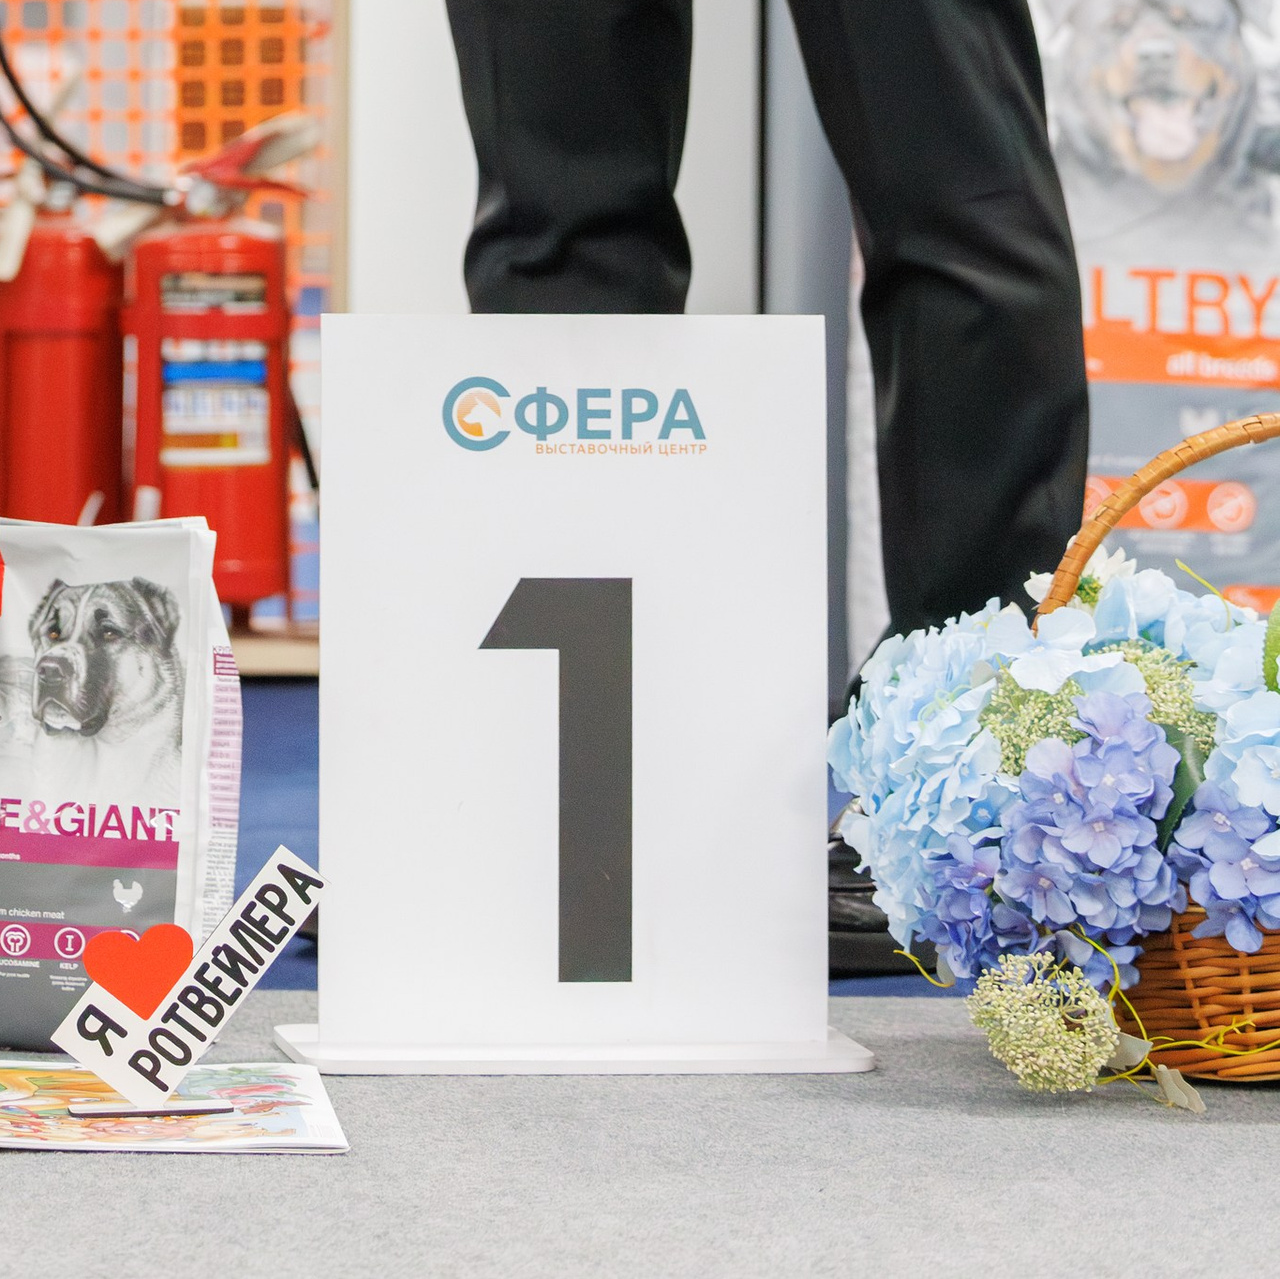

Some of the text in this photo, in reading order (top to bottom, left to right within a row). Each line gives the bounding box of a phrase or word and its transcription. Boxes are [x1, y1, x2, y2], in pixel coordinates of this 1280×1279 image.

[1091, 266, 1280, 336] LTRY
[442, 376, 707, 451] СФЕРА
[536, 441, 707, 456] ВЫСТАВОЧНЫЙ ЦЕНТР
[478, 578, 633, 982] 1
[8, 908, 41, 919] chicken
[42, 910, 65, 920] meat
[128, 863, 325, 1093] РОТВЕЙЛЕРА
[77, 1003, 128, 1057] Я
